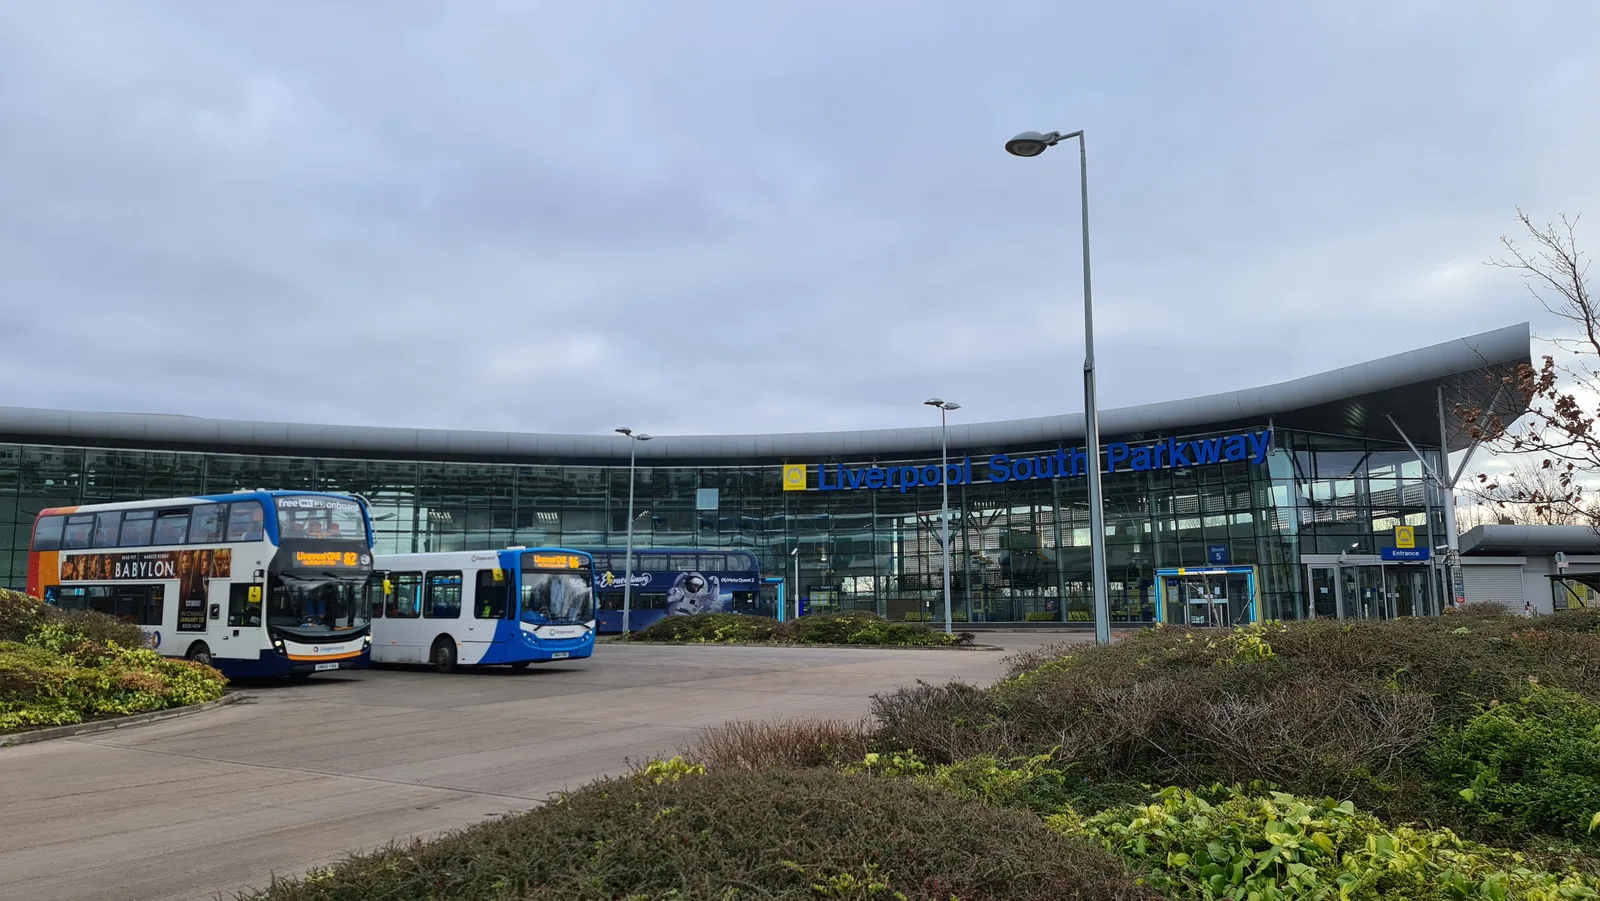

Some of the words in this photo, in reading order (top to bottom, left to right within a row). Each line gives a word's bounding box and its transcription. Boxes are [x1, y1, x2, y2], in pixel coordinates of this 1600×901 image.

[818, 456, 972, 494] Liverpool
[988, 444, 1087, 483] South
[1106, 430, 1271, 473] Parkway
[278, 499, 298, 507] free
[326, 501, 359, 511] onboard
[296, 551, 327, 560] Liverpool
[344, 551, 357, 566] 82
[115, 560, 174, 577] BABYLON
